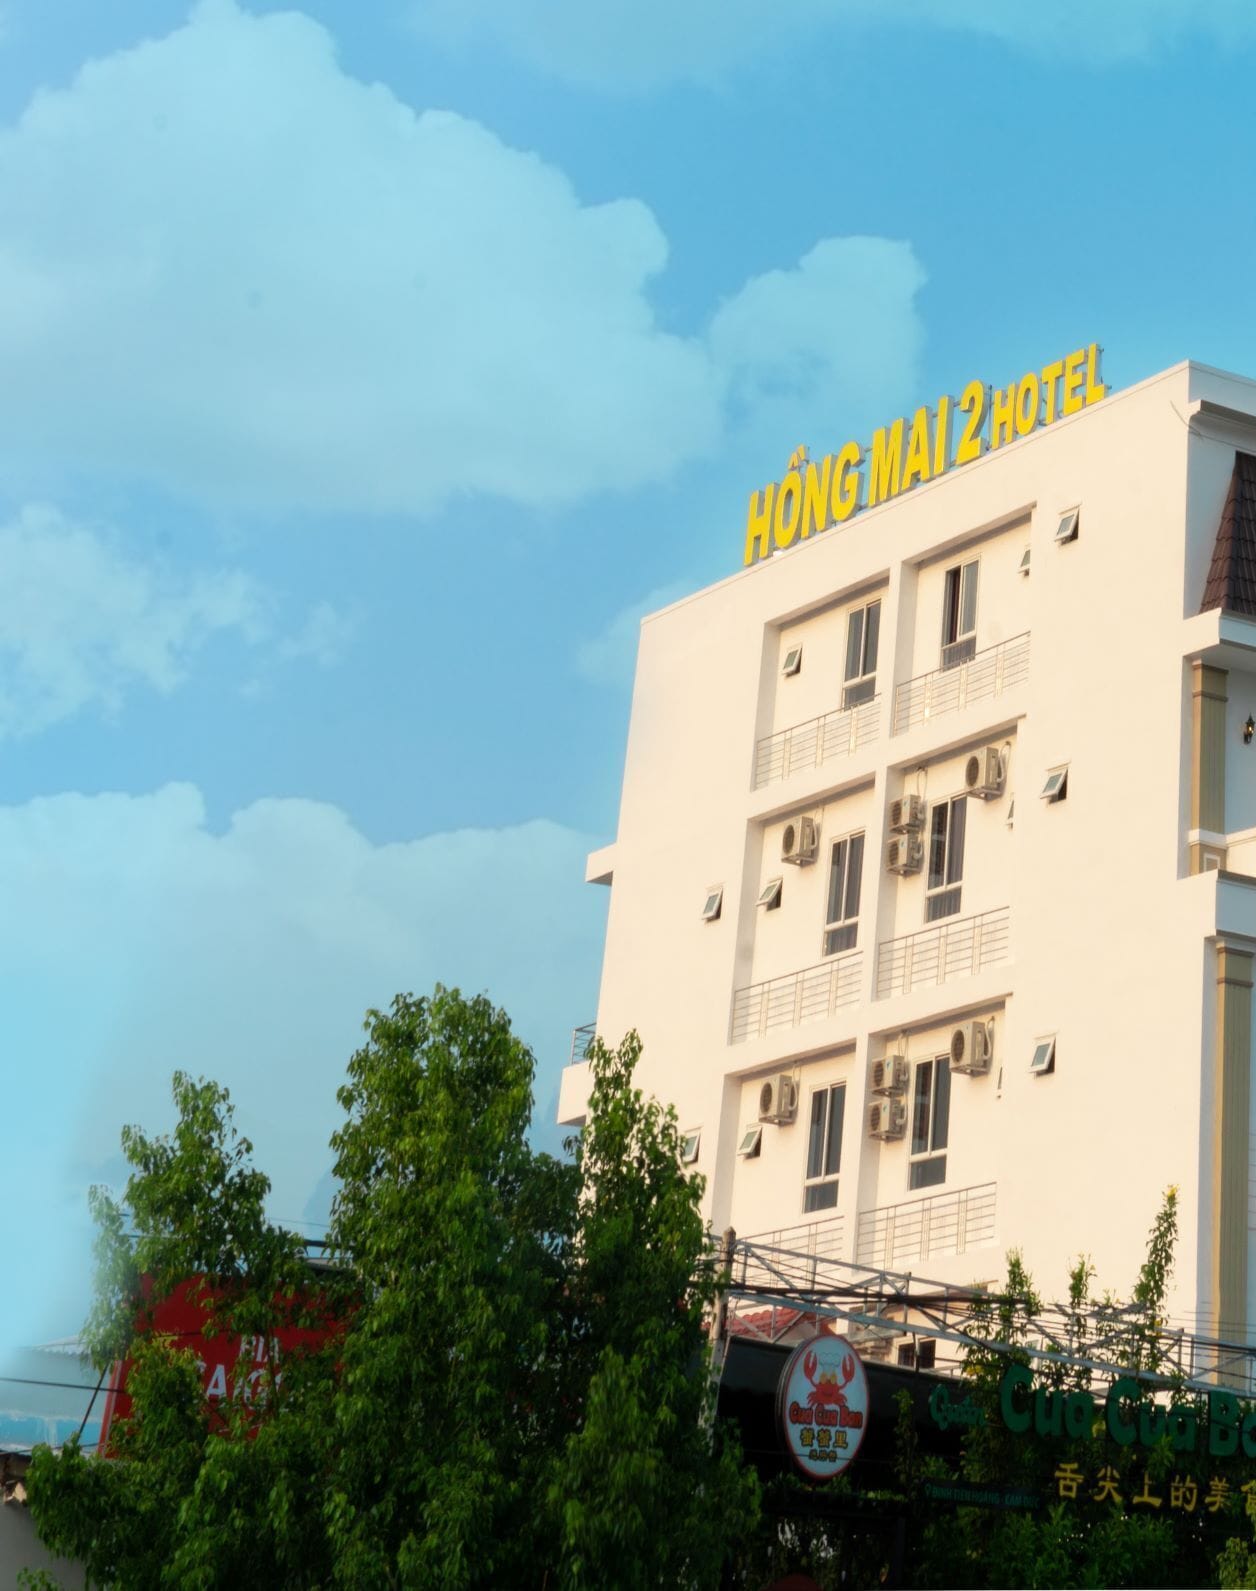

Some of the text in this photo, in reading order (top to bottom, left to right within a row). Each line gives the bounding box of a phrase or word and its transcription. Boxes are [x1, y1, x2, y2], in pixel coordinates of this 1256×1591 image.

[868, 395, 954, 507] MAI
[955, 379, 988, 466] 2
[991, 343, 1107, 449] HOTEL
[1000, 1363, 1096, 1438] Cua
[1105, 1375, 1199, 1450] Cua
